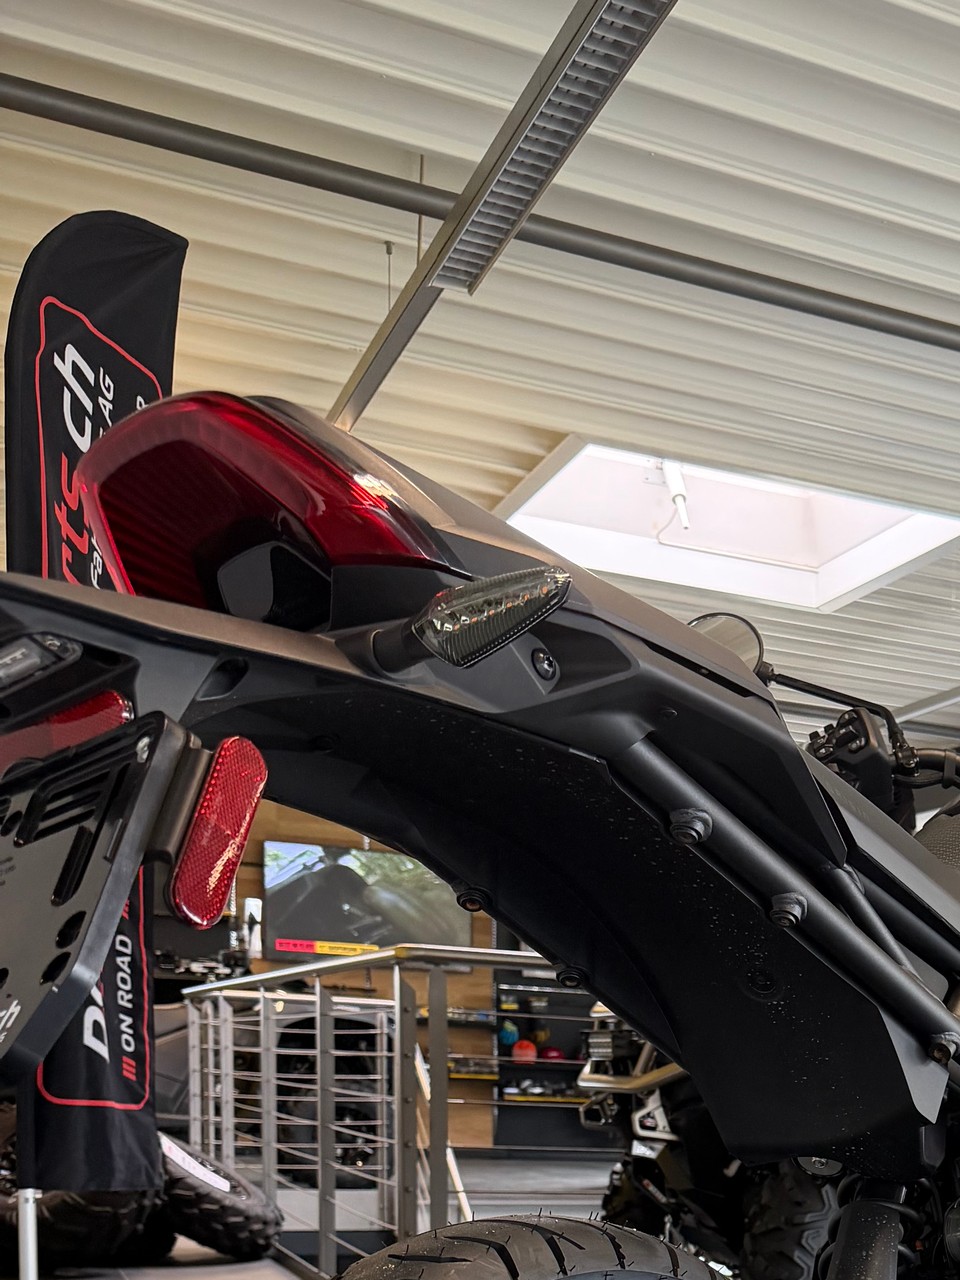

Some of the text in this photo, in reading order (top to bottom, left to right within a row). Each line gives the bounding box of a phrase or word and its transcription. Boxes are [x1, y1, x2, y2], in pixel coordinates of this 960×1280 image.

[99, 367, 115, 427] AG
[115, 934, 136, 1053] ON ROAD
